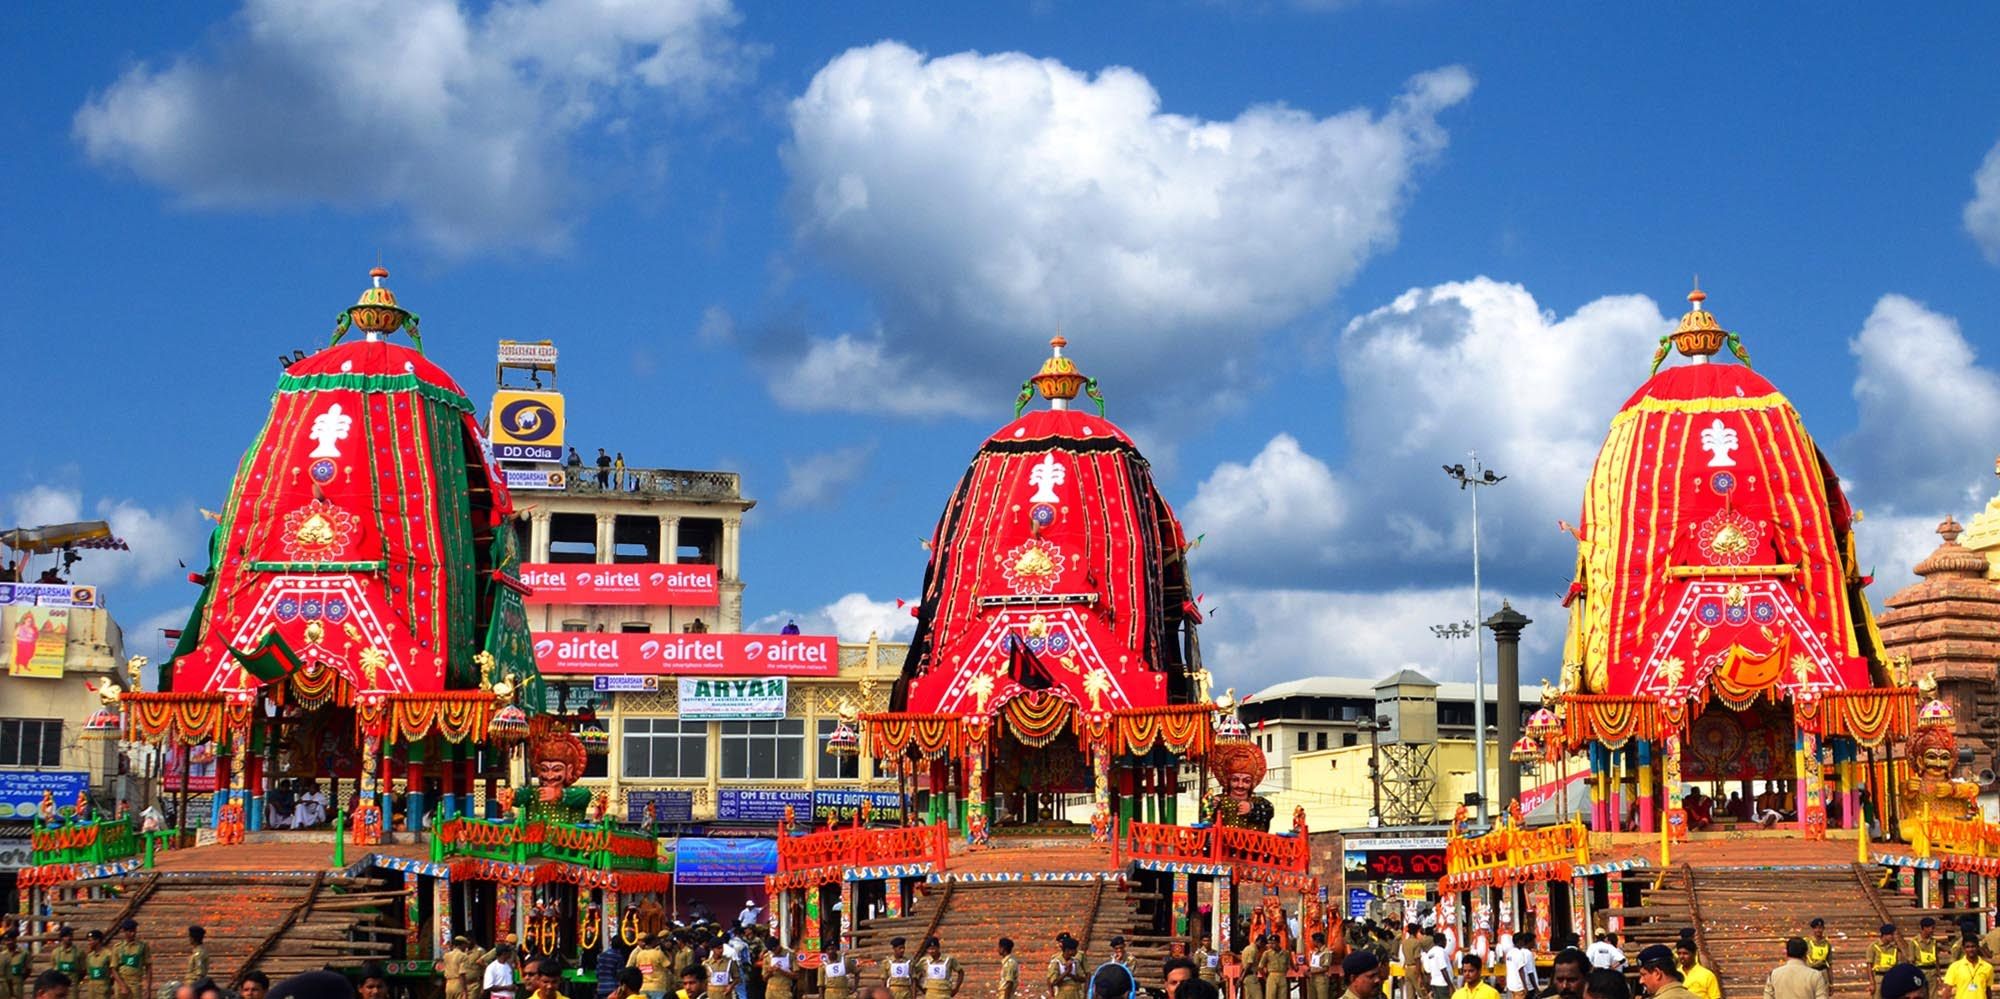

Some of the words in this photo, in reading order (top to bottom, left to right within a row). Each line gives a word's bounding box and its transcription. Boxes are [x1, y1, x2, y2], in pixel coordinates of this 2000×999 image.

[504, 446, 522, 457] DD
[525, 447, 552, 458] Odia
[520, 571, 567, 586] airtel
[594, 571, 641, 587] airtel
[667, 572, 713, 588] airtel
[557, 637, 619, 659] airtel
[663, 638, 724, 660] airtel
[767, 639, 827, 662] airtel
[694, 679, 784, 697] ARYAN
[740, 791, 756, 800] OM
[759, 792, 777, 800] EYE
[780, 792, 810, 800] CLINIC
[816, 793, 842, 805] STYLE
[876, 795, 900, 807] STUDI
[882, 808, 900, 820] STAN
[832, 965, 839, 974] S
[896, 966, 903, 975] S
